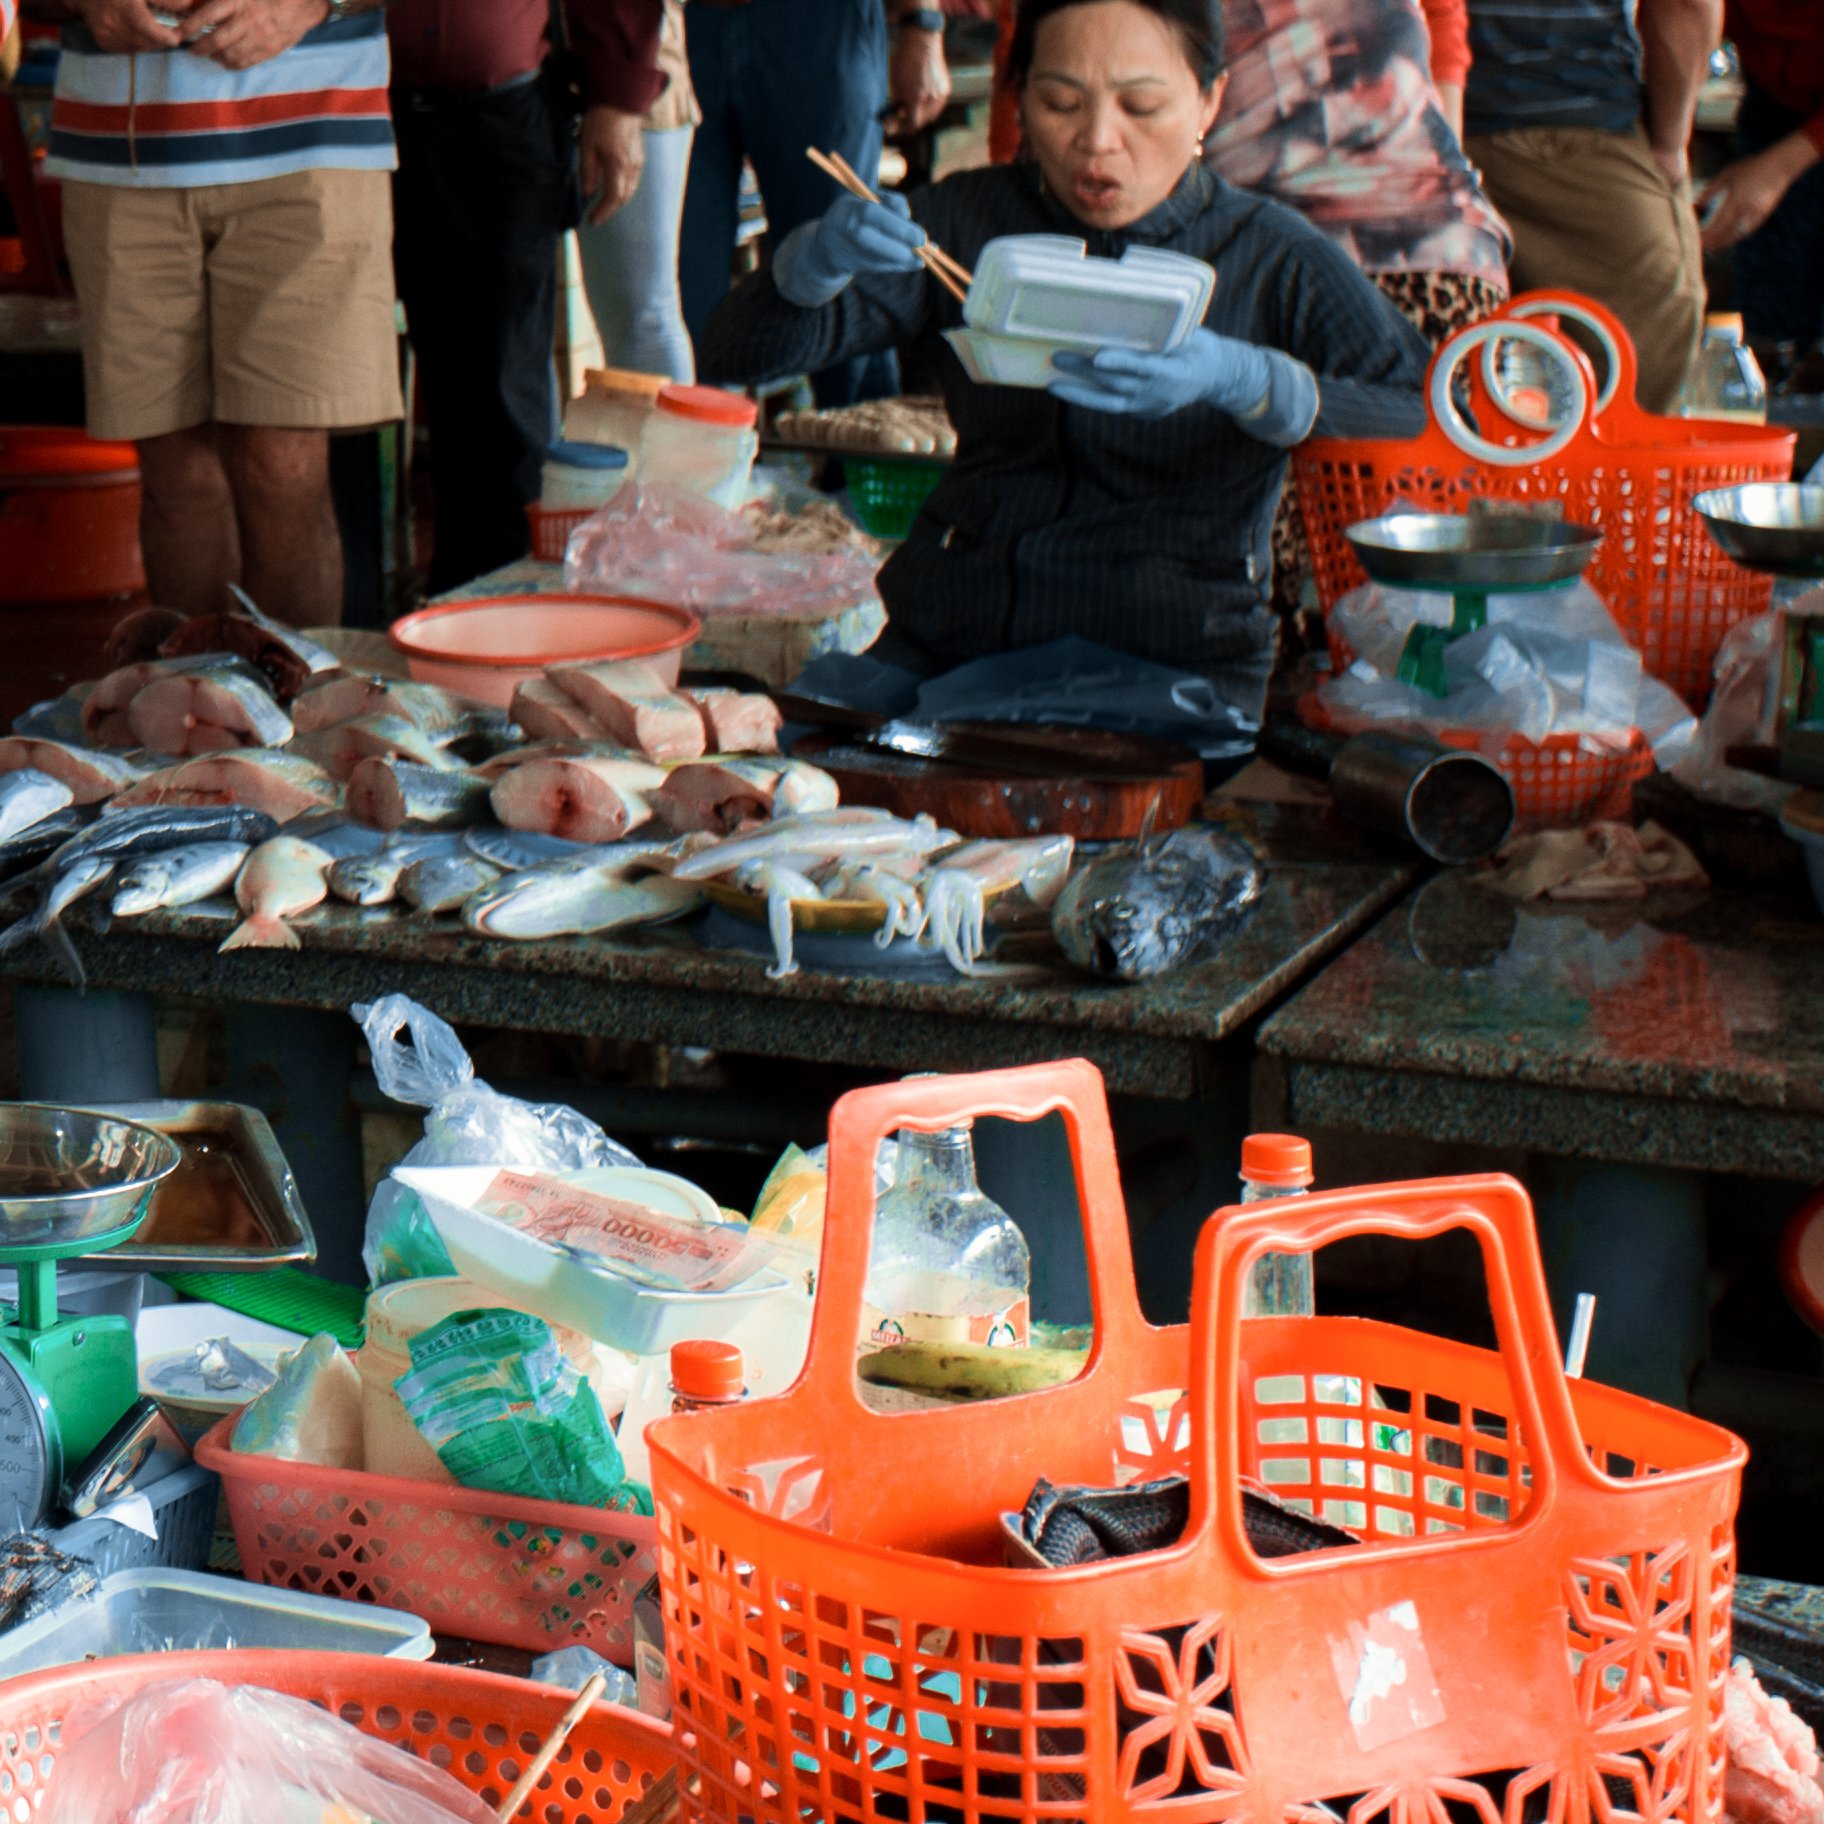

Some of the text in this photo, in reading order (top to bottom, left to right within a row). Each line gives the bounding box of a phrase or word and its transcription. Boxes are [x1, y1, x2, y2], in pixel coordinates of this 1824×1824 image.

[603, 1218, 690, 1255] 50000
[5, 1434, 21, 1445] 400
[0, 1460, 21, 1474] 500
